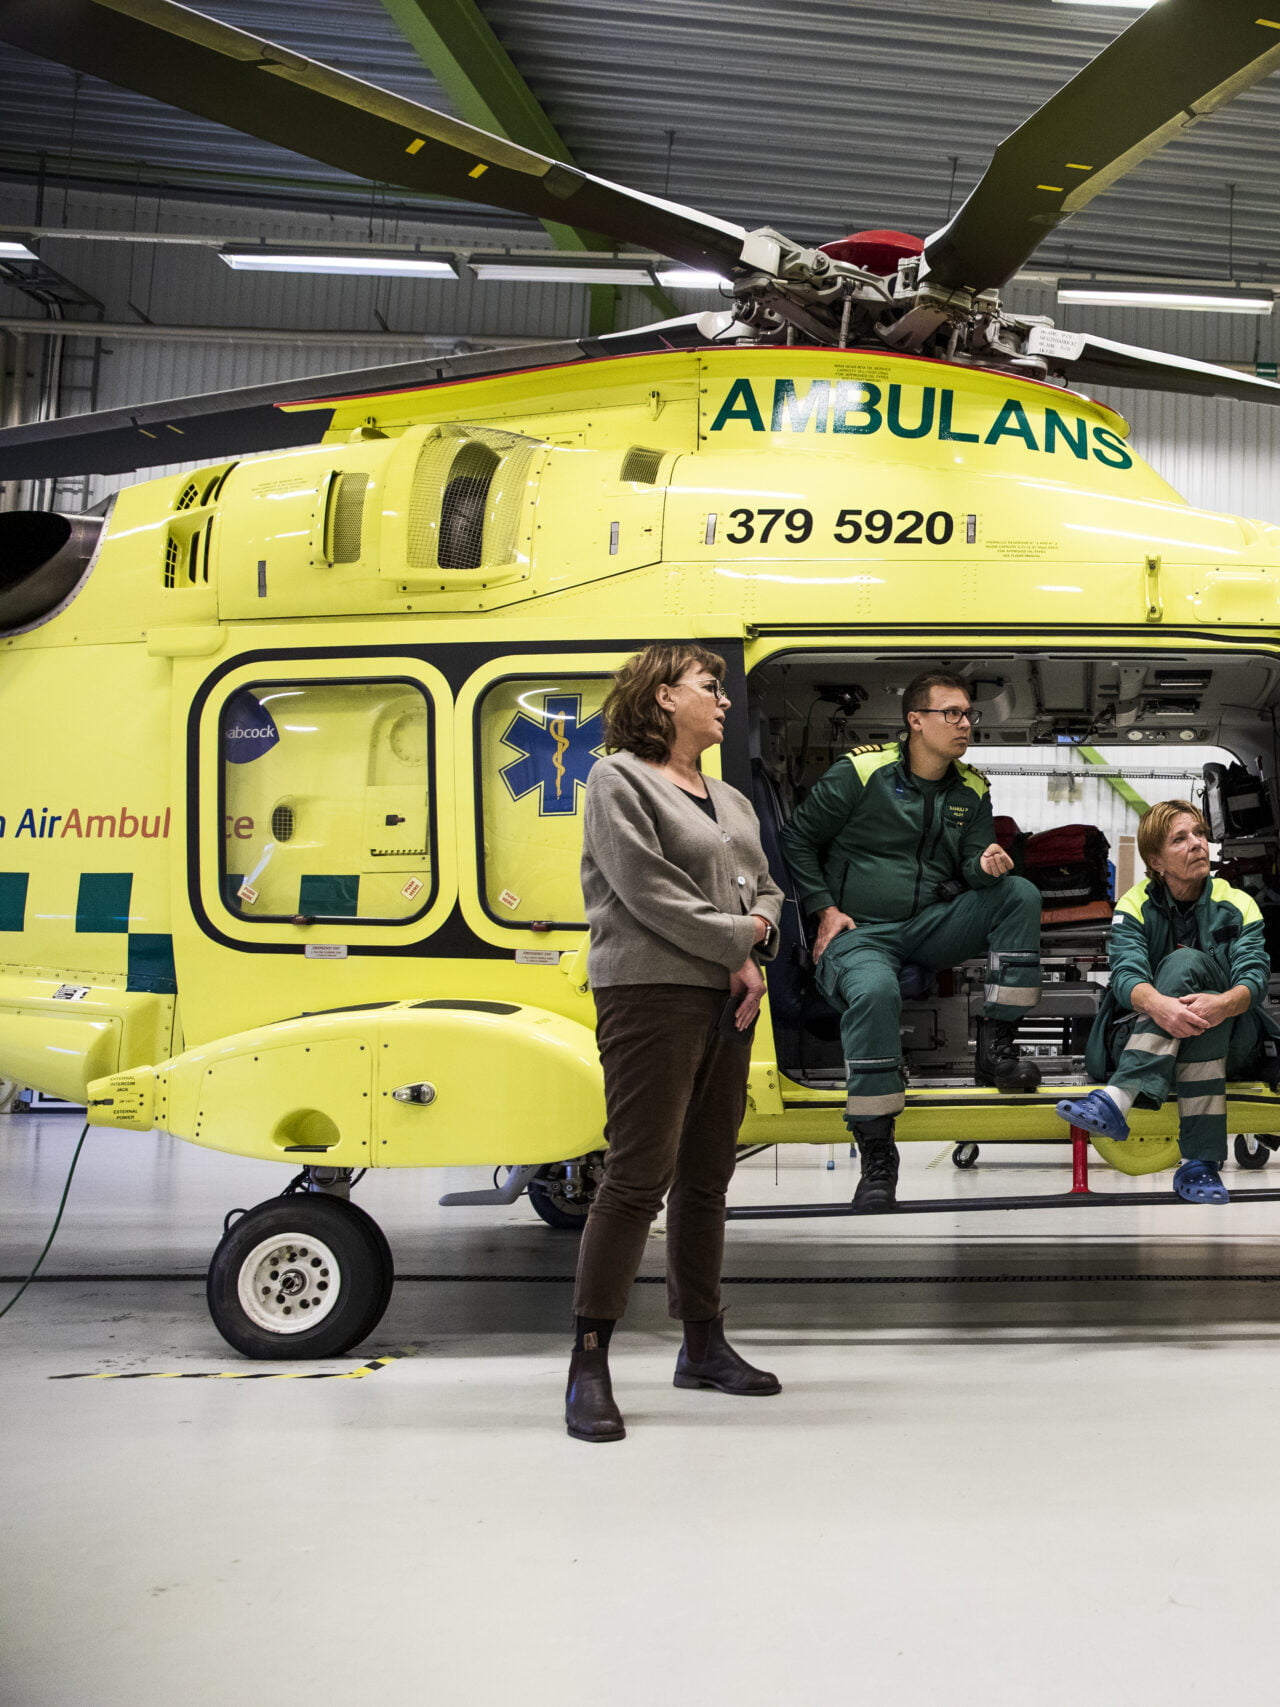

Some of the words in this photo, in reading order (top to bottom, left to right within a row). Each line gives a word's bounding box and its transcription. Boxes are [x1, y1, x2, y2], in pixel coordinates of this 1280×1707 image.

[710, 378, 1133, 470] AMBULANS
[726, 509, 813, 544] 379
[834, 510, 954, 545] 5920
